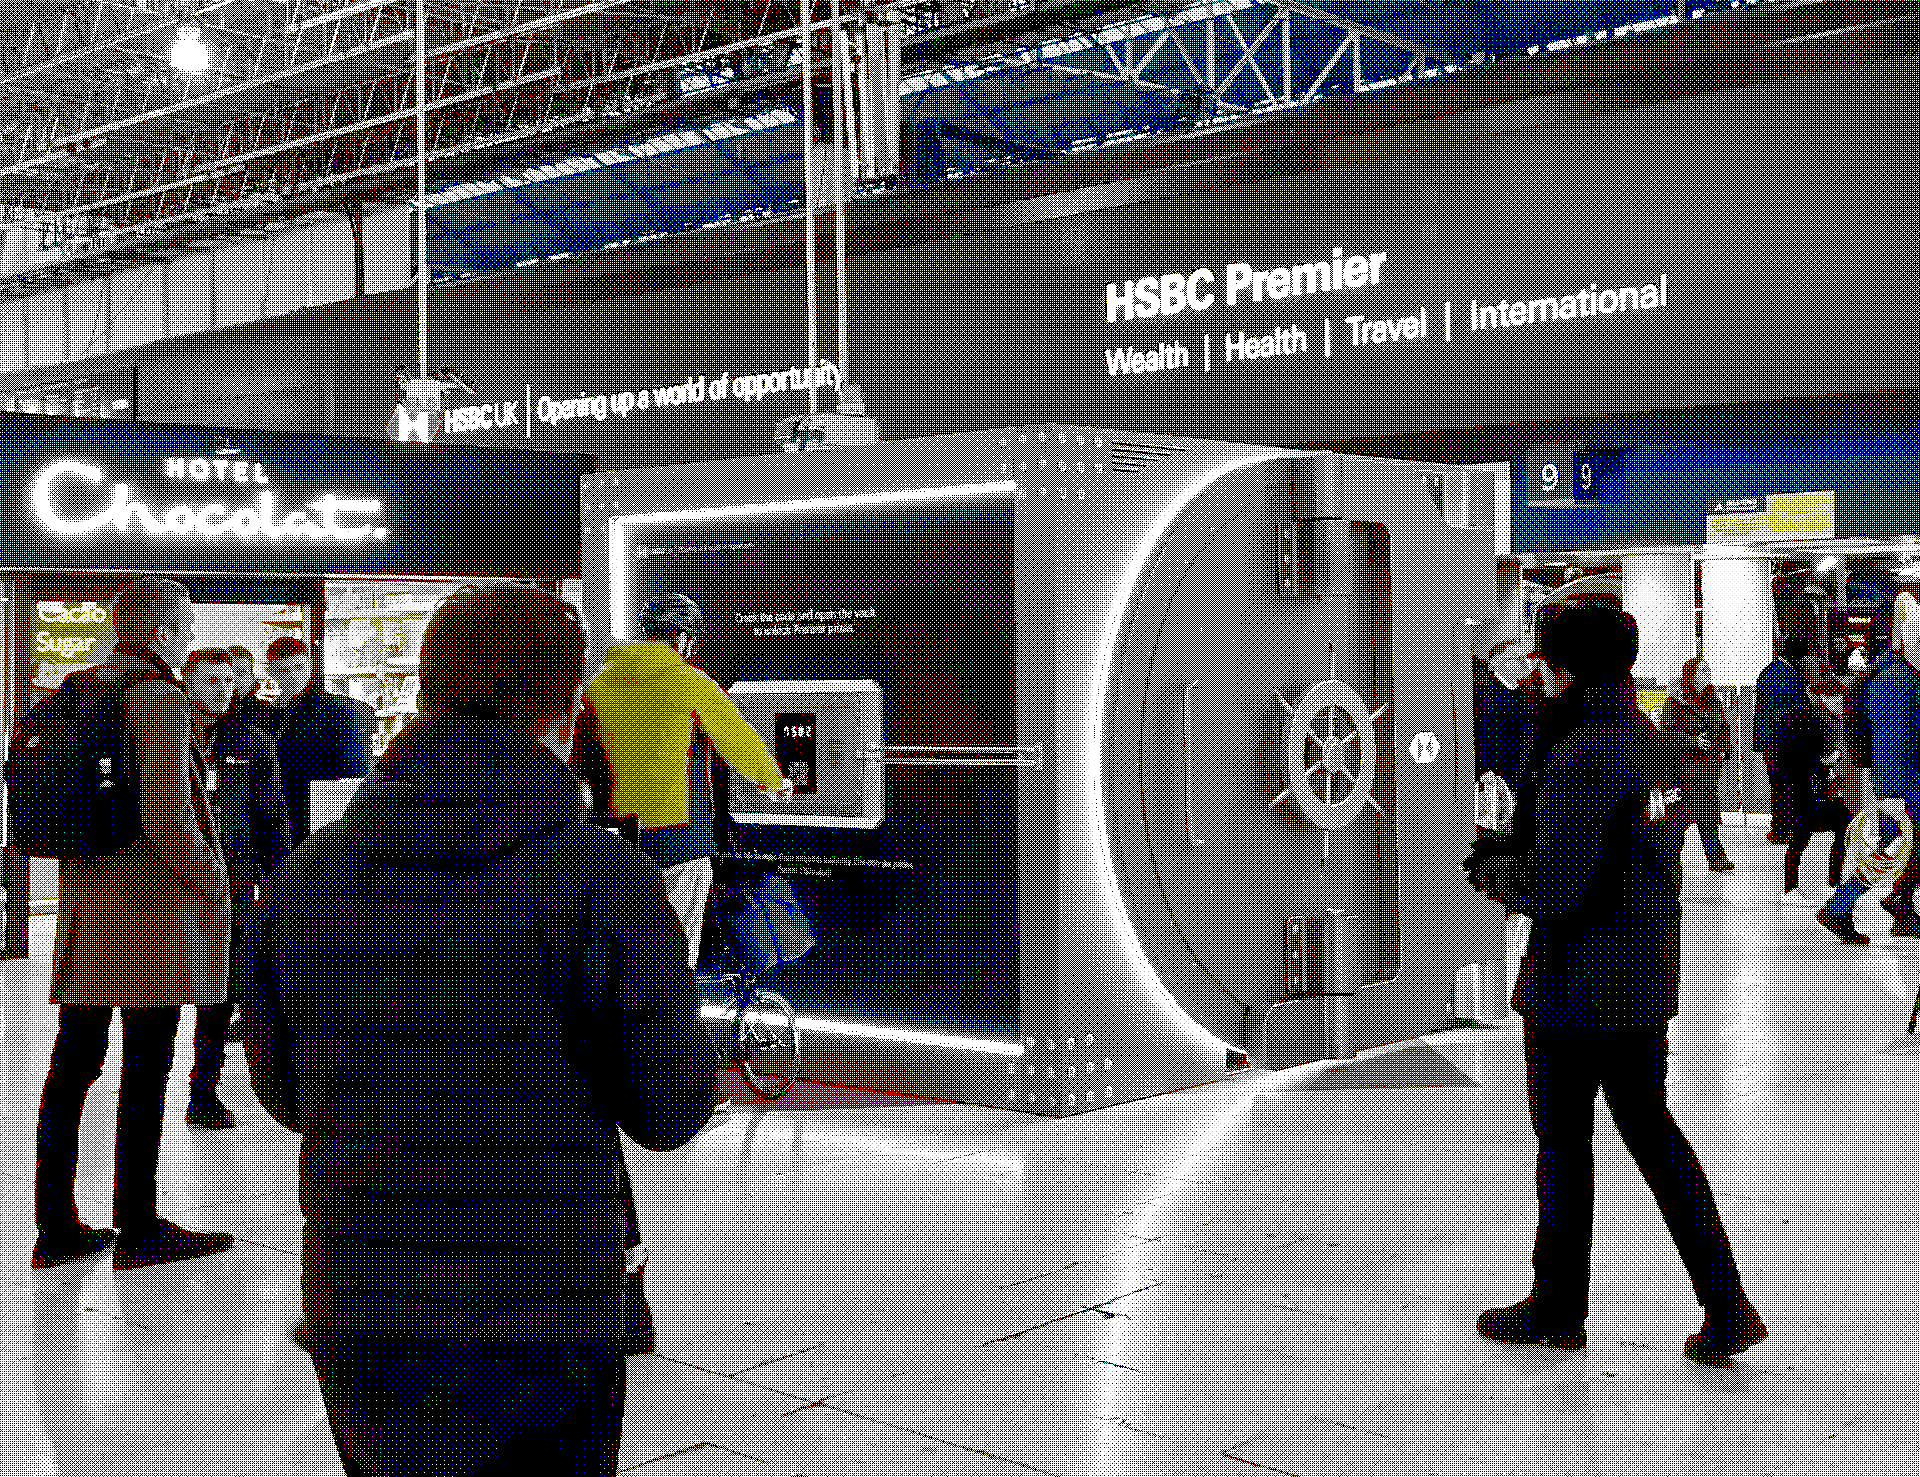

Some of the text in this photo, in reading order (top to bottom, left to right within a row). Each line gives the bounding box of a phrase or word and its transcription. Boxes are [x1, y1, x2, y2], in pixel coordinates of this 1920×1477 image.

[1106, 247, 1387, 323] HSBC Premier
[1105, 273, 1667, 376] Wealth Health Travel International
[444, 359, 842, 433] HSBC UK Opening up a world of opportunity
[164, 457, 269, 484] HOTEL
[1541, 463, 1559, 492] 9
[1581, 463, 1592, 490] 9
[36, 601, 107, 623] Cacao
[36, 631, 97, 659] Sugar
